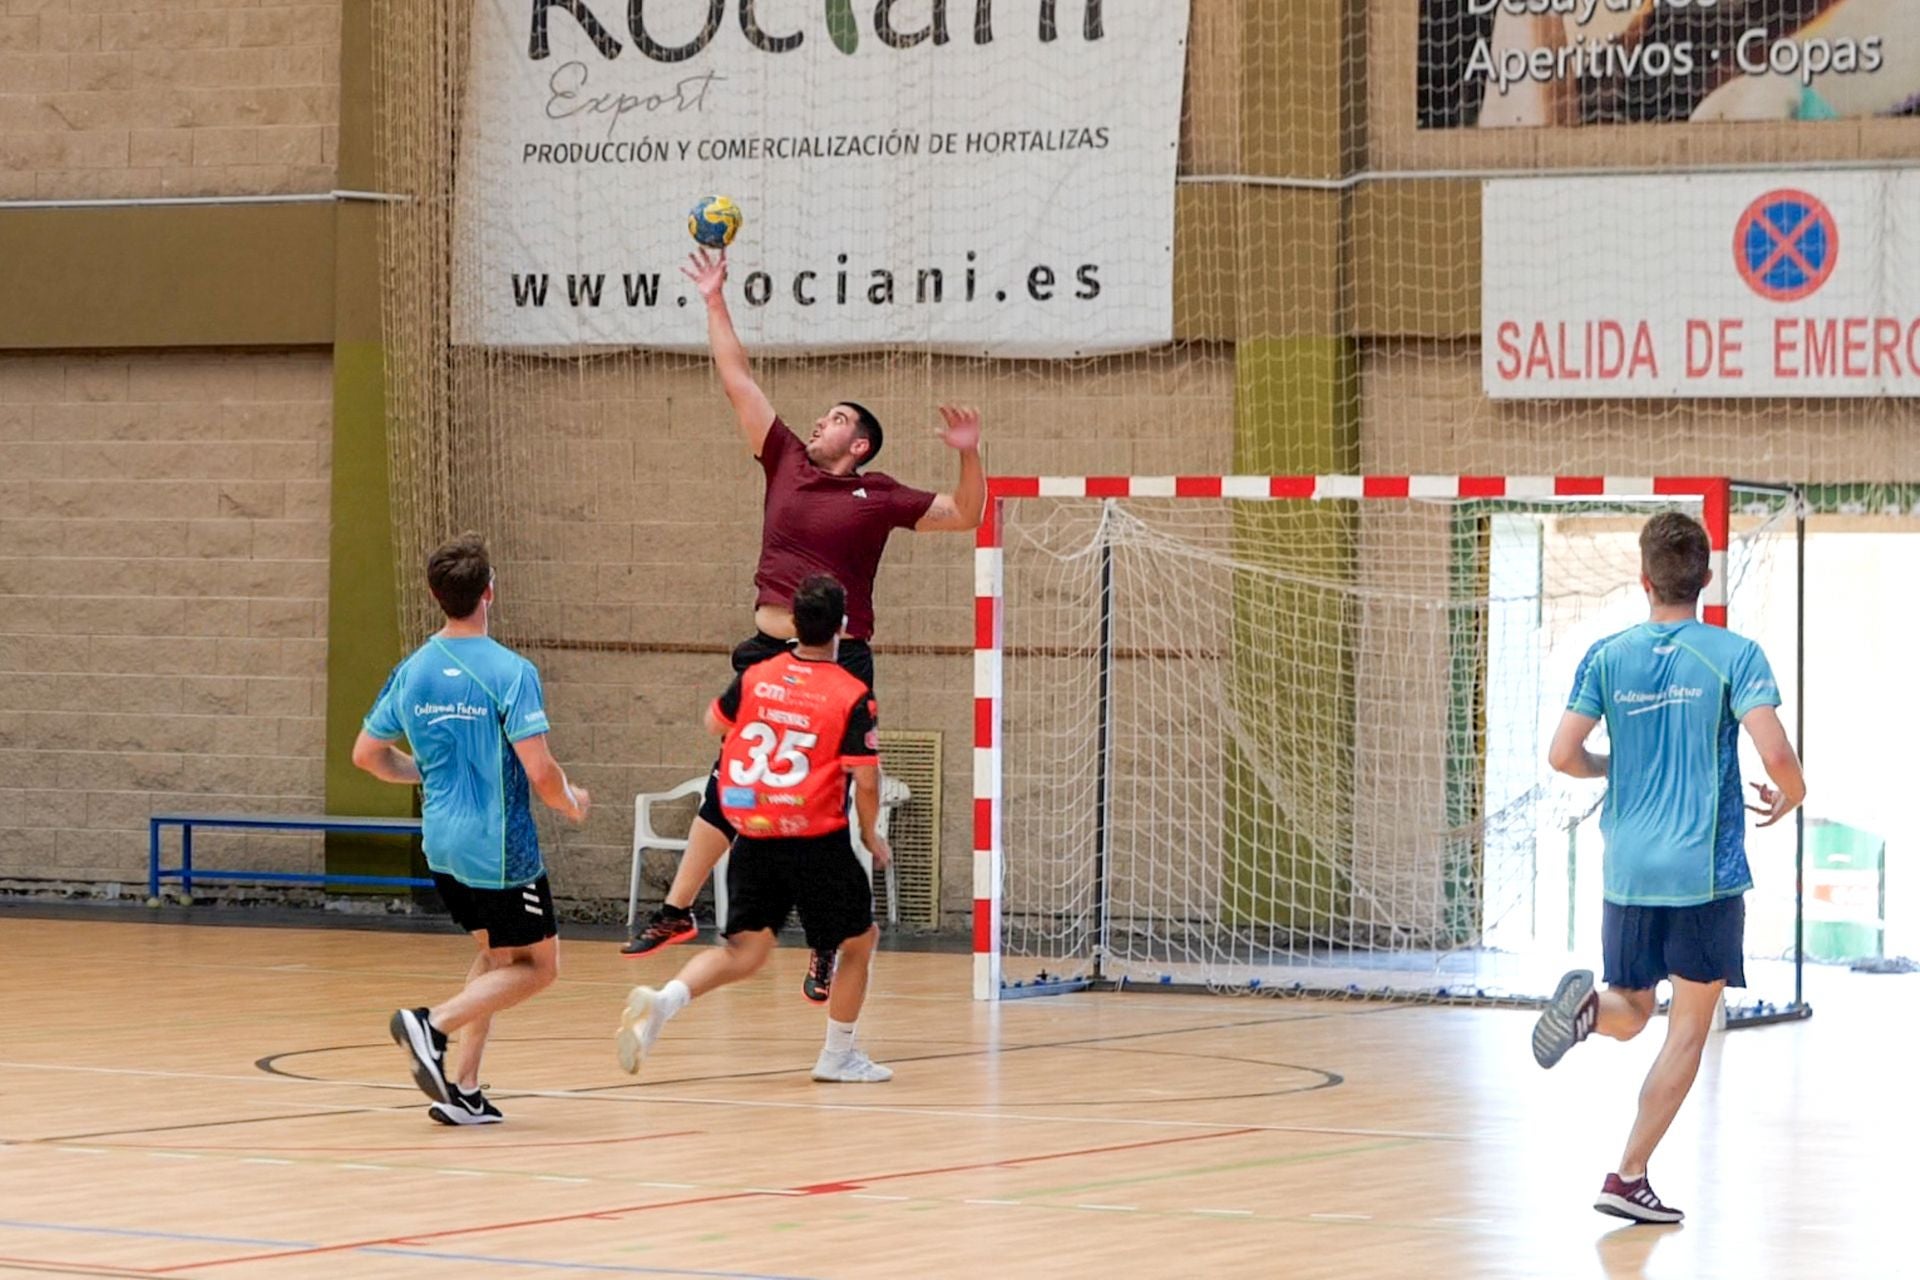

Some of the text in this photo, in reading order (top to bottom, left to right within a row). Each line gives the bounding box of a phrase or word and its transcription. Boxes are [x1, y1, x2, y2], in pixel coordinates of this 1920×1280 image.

[1464, 28, 1883, 94] Aperitivos Copas
[546, 60, 728, 137] Export
[522, 126, 1110, 165] PRODUCCIÓN Y COMERCIALIZACIÓN DE HORTALIZAS
[511, 250, 1101, 307] www.ociani.es
[1497, 320, 1659, 381] SALIDA
[1686, 319, 1744, 379] DE
[729, 721, 817, 788] 35
